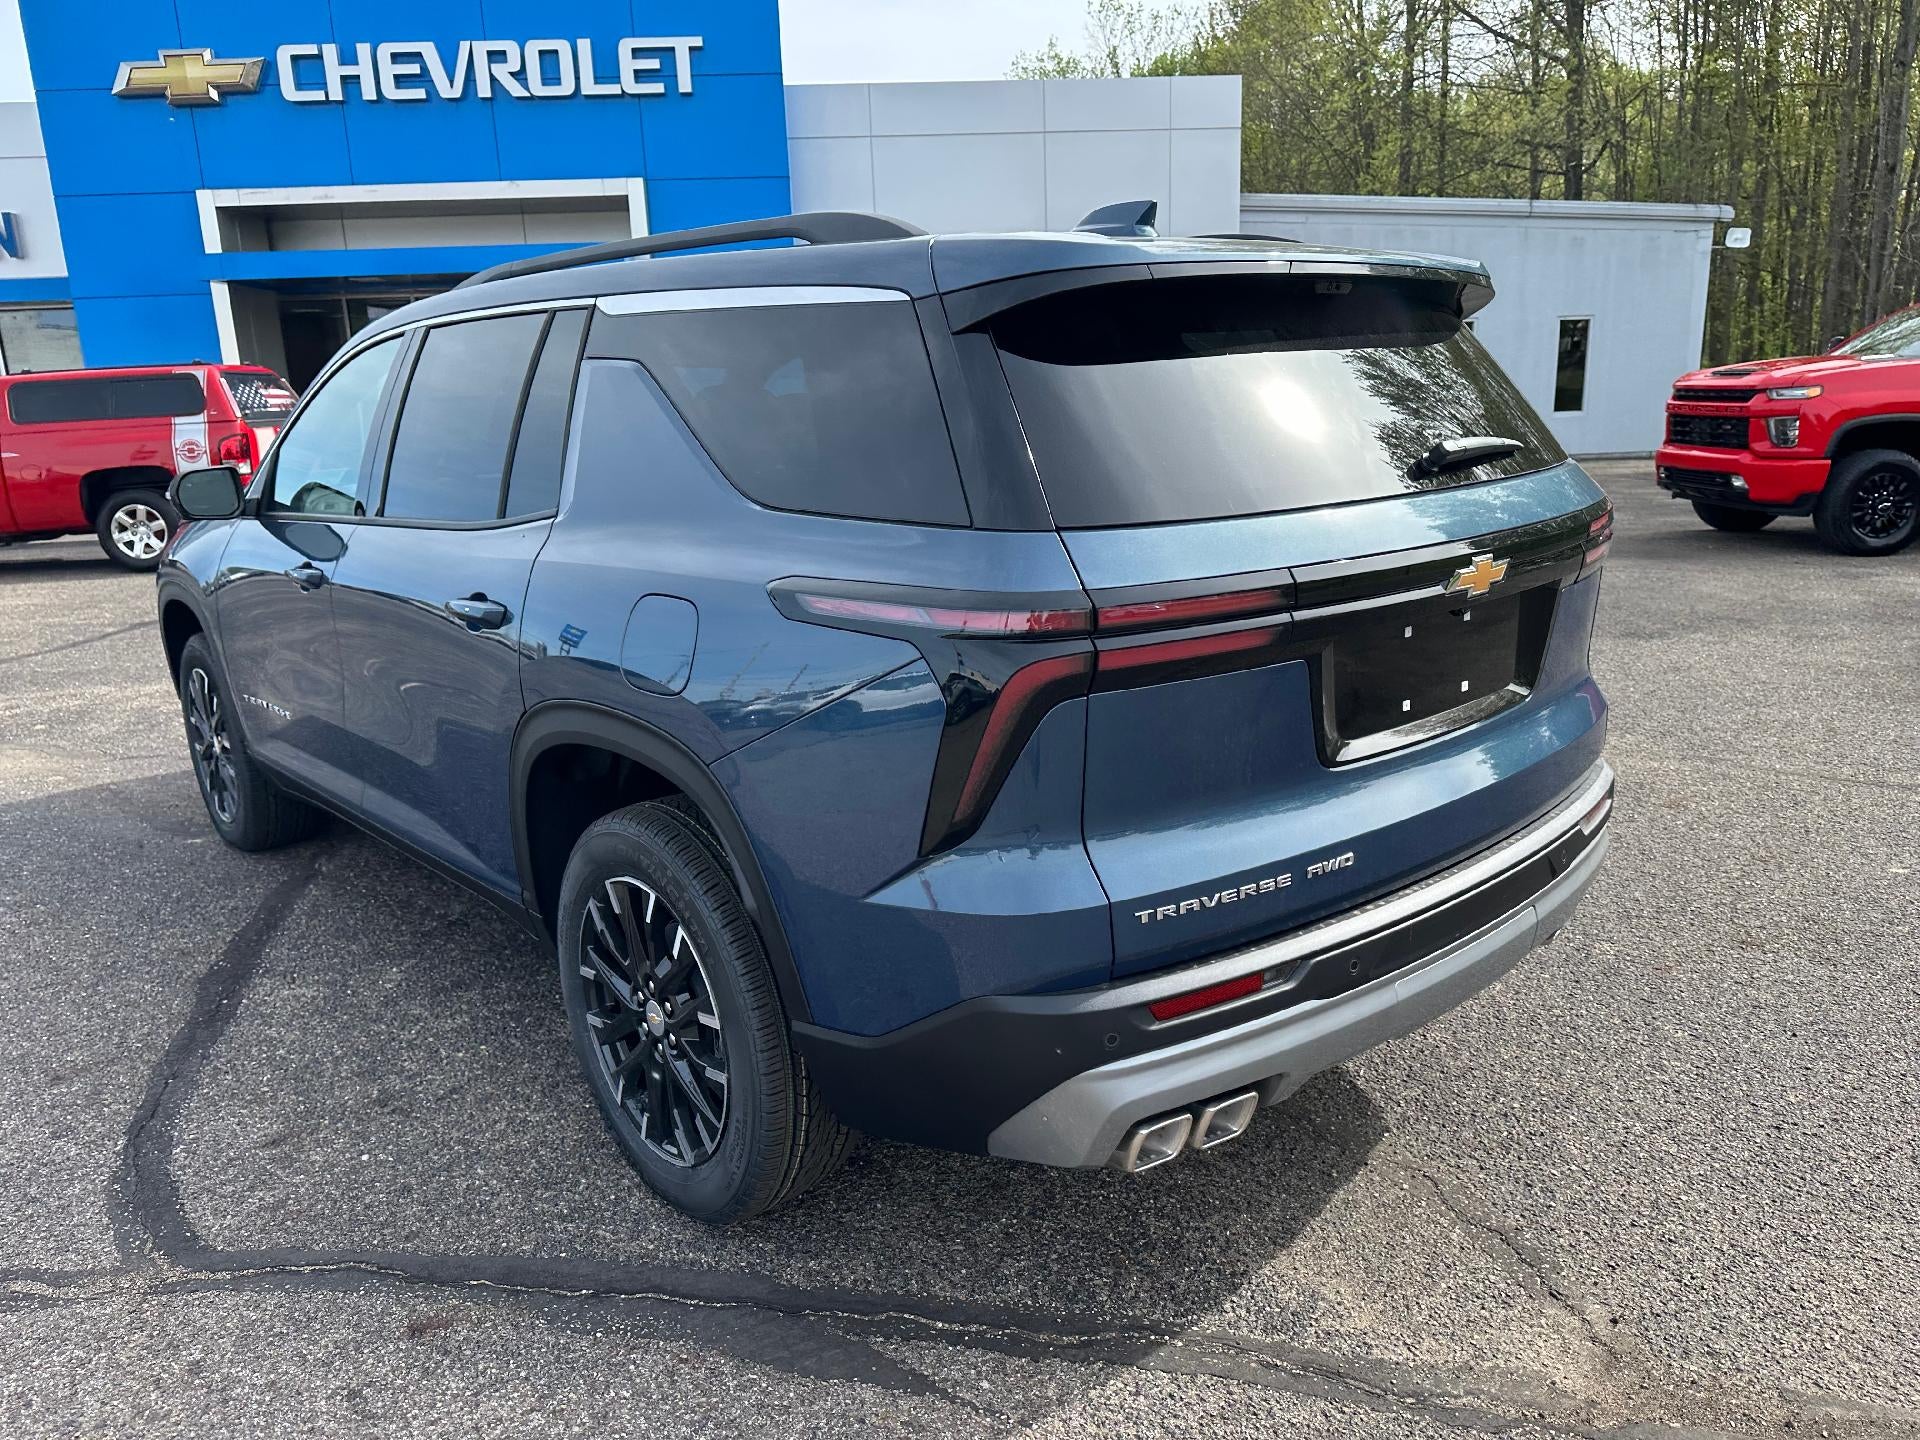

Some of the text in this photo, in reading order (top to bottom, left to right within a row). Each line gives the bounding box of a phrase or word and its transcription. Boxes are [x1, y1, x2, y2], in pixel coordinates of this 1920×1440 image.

[276, 36, 704, 102] CHEVROLET
[1134, 851, 1355, 924] TRAVERSE AWD
